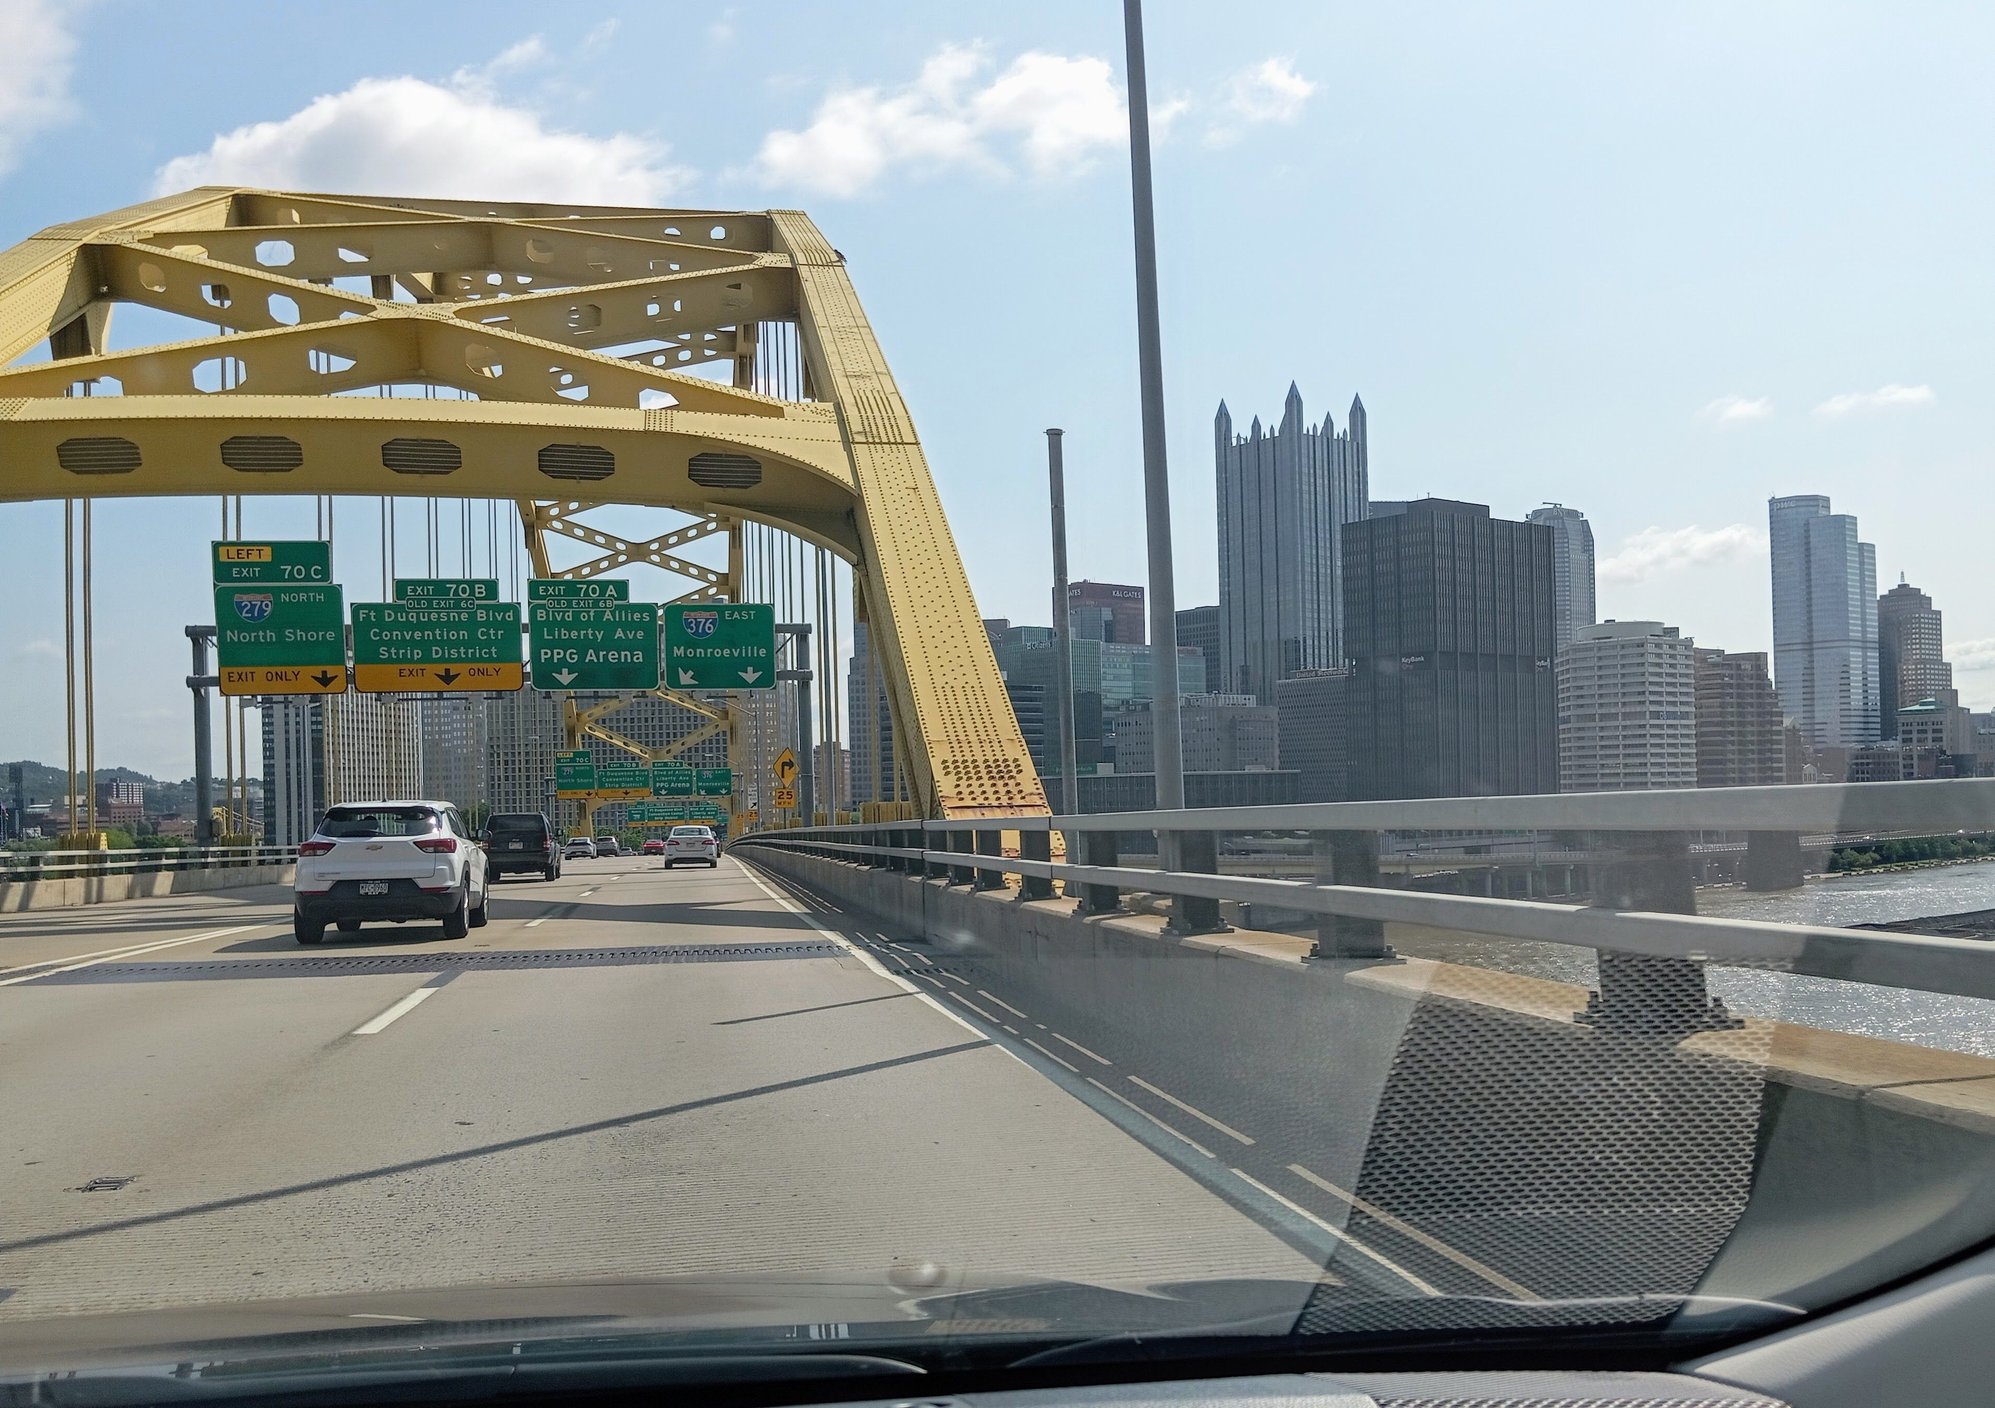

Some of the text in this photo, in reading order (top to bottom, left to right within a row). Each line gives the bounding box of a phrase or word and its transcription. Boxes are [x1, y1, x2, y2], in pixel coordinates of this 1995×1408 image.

[226, 548, 264, 560] LEFT
[232, 568, 261, 577] EXIT
[407, 586, 434, 596] EXIT
[539, 586, 565, 595] EXIT
[281, 593, 324, 602] NORTH
[241, 601, 272, 617] 279
[359, 610, 514, 623] Ft Duquesne Blvd
[537, 610, 650, 621] Blvd of Allies
[725, 611, 756, 620] EAST
[688, 618, 714, 633] 376
[227, 629, 336, 642] North Shore
[370, 628, 504, 640] Convention Ctr
[544, 628, 644, 642] Liberty Ave
[379, 646, 497, 660] Strip District
[540, 649, 643, 663] PPG Arena
[673, 646, 766, 657] Monroeville
[1402, 656, 1424, 664] KeyBank
[228, 671, 301, 682] EXIT ONLY
[399, 668, 501, 677] EXIT ONLY
[778, 791, 793, 800] 25
